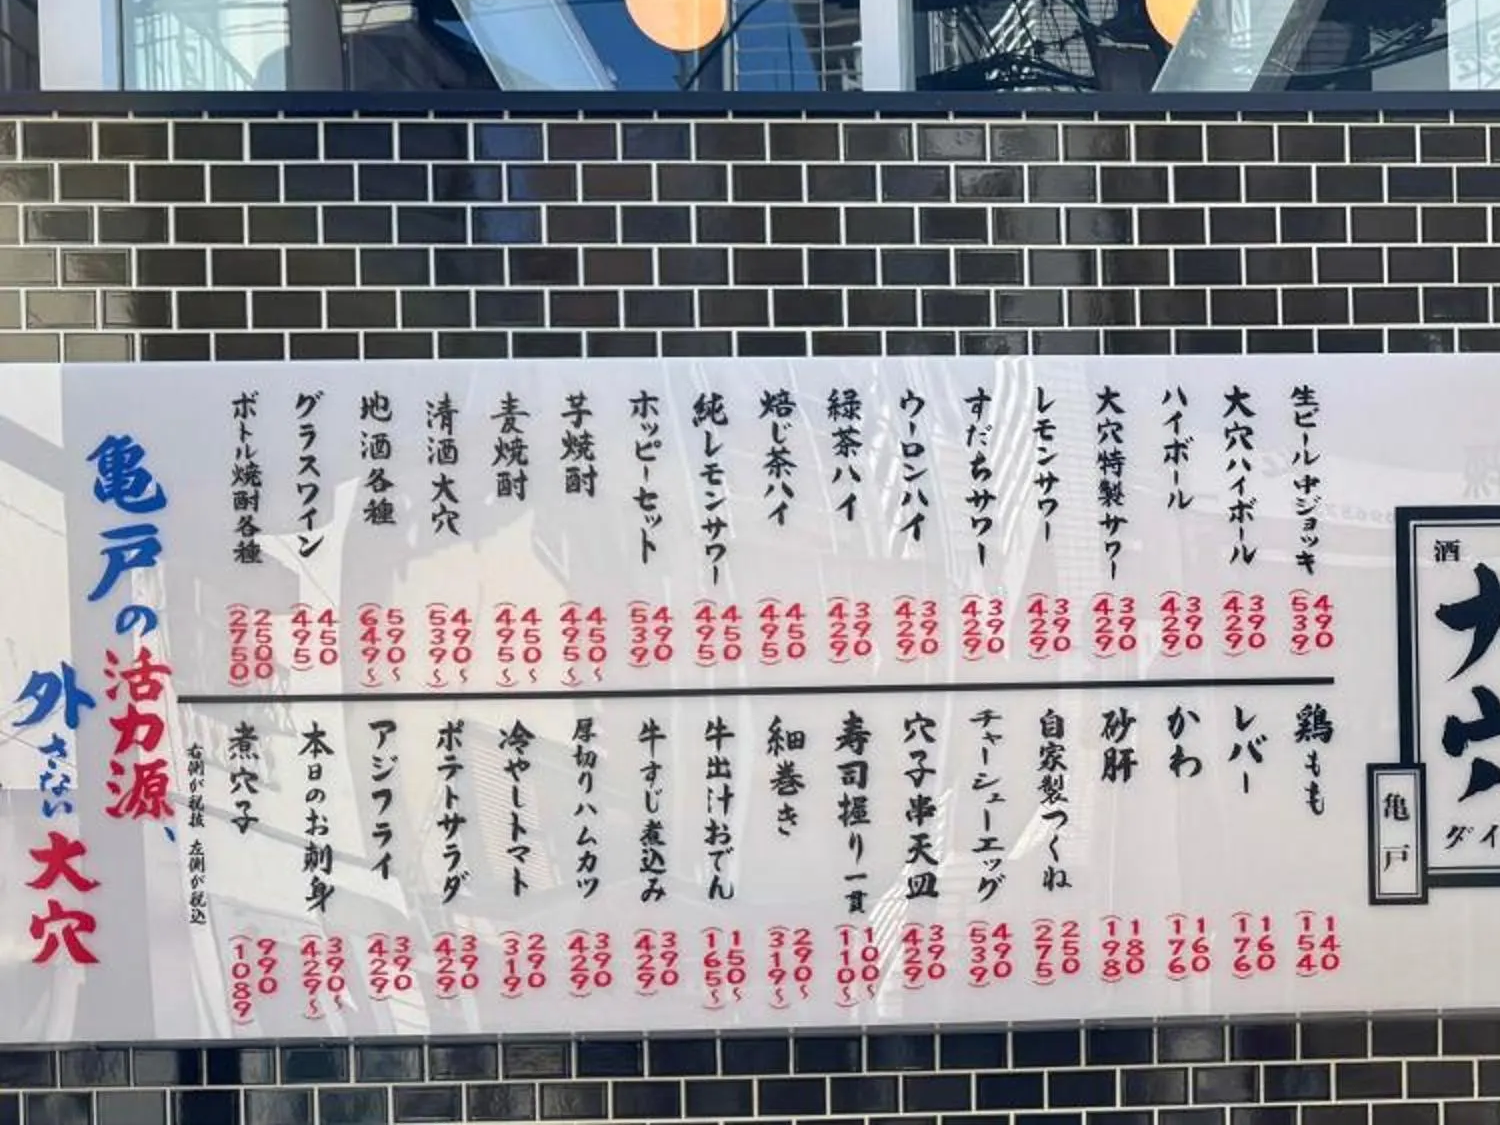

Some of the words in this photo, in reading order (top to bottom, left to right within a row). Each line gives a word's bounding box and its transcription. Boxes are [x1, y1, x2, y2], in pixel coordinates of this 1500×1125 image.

[295, 390, 325, 559] グラスワイン
[359, 390, 397, 526] 地酒各種
[425, 391, 461, 536] 清酒大穴
[490, 391, 531, 502] 麦焼酎
[559, 390, 599, 498] 芋焼酎
[628, 389, 663, 565] ホッピーセット
[691, 391, 729, 586] 純レモンサワー
[826, 388, 863, 522] 緑茶ハイ
[899, 388, 930, 542] ウーロンハイ
[963, 386, 998, 568] すだちサワー
[1031, 386, 1061, 543] レモンサワー
[1095, 384, 1129, 581] 大穴特製サワー
[1161, 385, 1195, 510] ハイボール
[1222, 384, 1257, 566] 大穴ハイボール
[1290, 384, 1322, 576] 生ビール中ジョッキ
[254, 609, 273, 679] 2500
[317, 609, 339, 665] 450
[652, 605, 673, 661] 490
[721, 605, 742, 661] 450
[785, 603, 806, 659] 450
[853, 602, 873, 657] 390
[920, 601, 939, 655] 390
[987, 599, 1005, 653] 390
[1053, 598, 1072, 652] 390
[1118, 597, 1137, 652] 390
[1185, 596, 1204, 650] 390
[1247, 595, 1266, 649] 390
[1313, 595, 1335, 648] 490
[228, 720, 260, 835] 煮穴子
[766, 714, 807, 837] 細巻き
[1100, 706, 1139, 784] 砂肝
[1166, 705, 1203, 778] かわ
[1227, 704, 1268, 794] レバー
[1293, 702, 1335, 816] 鶏もも
[10, 659, 102, 967] 外さない大穴
[297, 720, 336, 914] 本日のお刺身
[367, 719, 399, 880] アジフライ
[435, 718, 470, 904] ポテトサラダ
[498, 719, 536, 898] 冷やしトマト
[571, 716, 600, 899] 厚切りハムカツ
[638, 717, 667, 903] 牛すじ煮込み
[703, 715, 736, 900] 牛出汁おでん
[903, 710, 940, 901] 穴子串天皿
[969, 708, 1007, 903] チャーシューエッグ
[1036, 707, 1073, 892] 自家製つくね
[1382, 792, 1410, 873] 亀戸
[257, 938, 279, 995] 990
[393, 936, 413, 991] 390
[461, 935, 480, 990] 390
[527, 933, 547, 989] 290
[593, 932, 613, 988] 390
[660, 931, 679, 987] 390
[927, 924, 947, 981] 390
[991, 922, 1014, 978] 490
[1061, 921, 1082, 975] 250
[1125, 918, 1146, 974] 180
[1191, 916, 1212, 972] 160
[1256, 915, 1277, 971] 160
[1319, 915, 1342, 971] 140
